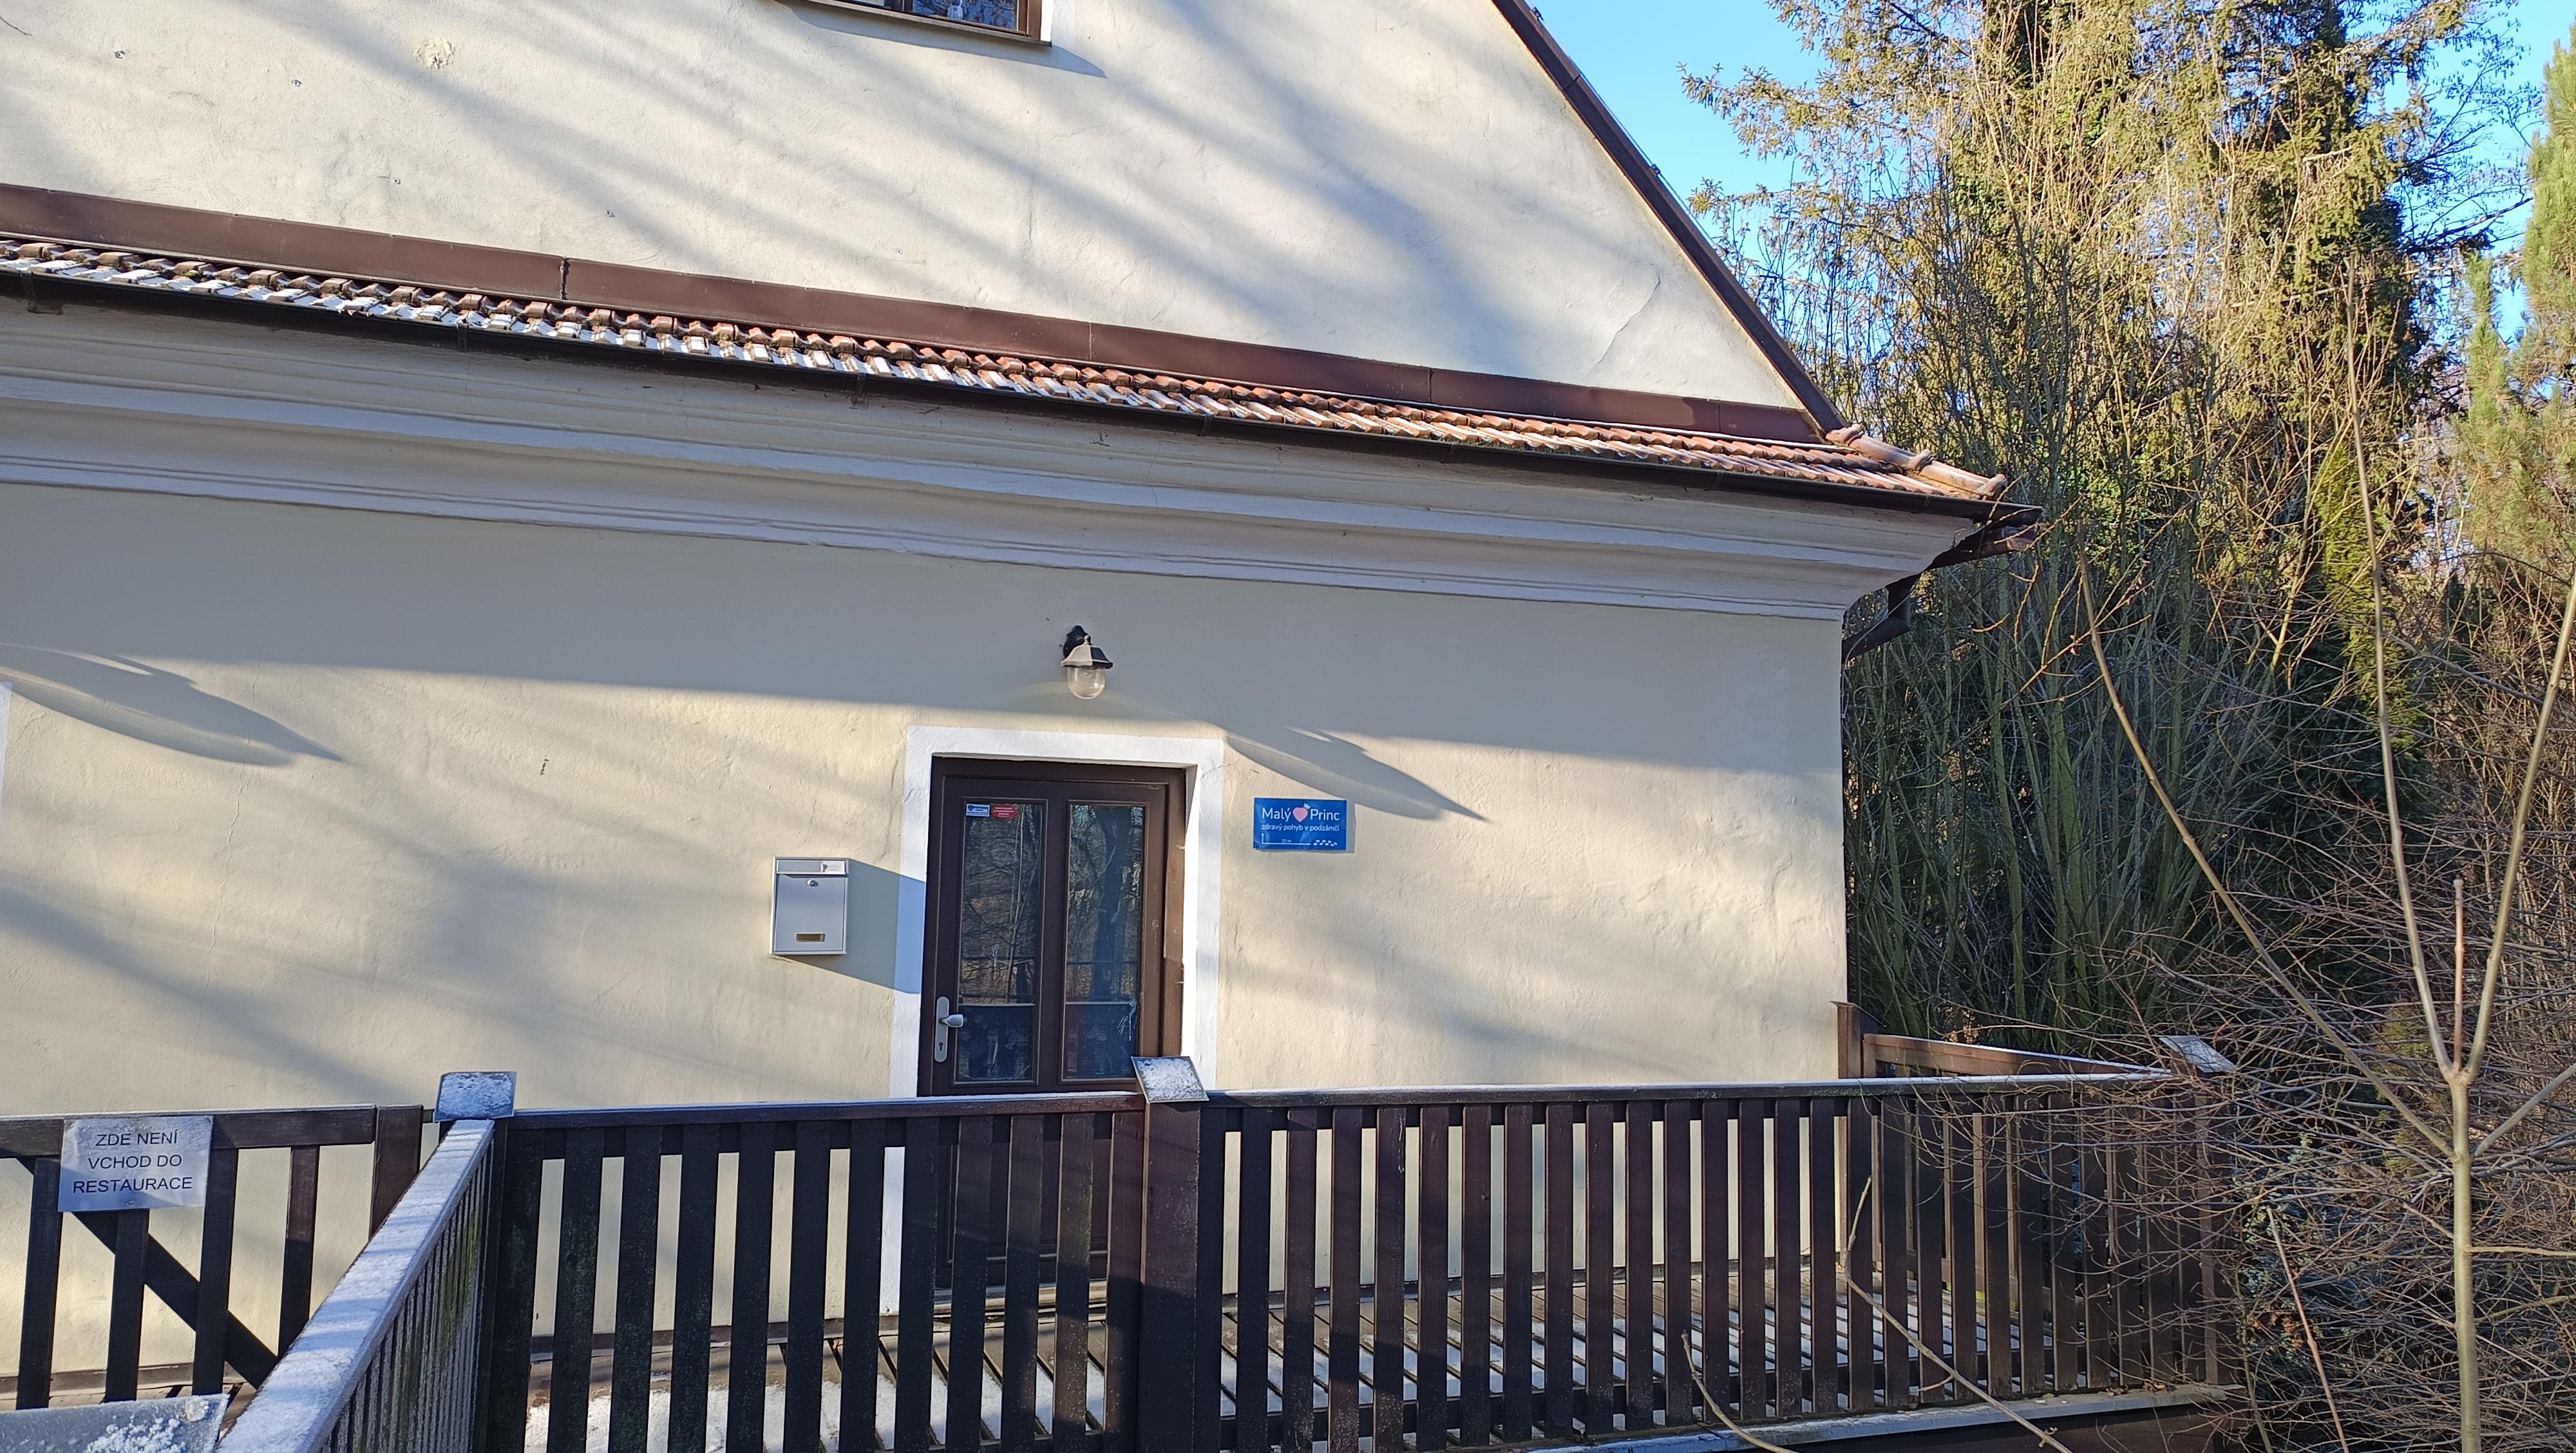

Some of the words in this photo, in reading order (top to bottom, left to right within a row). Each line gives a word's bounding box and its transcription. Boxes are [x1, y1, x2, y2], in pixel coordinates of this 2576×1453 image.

[1262, 807, 1291, 822] Malý
[1310, 808, 1340, 821] Princ
[1261, 823, 1283, 831] zdravý
[95, 1134, 131, 1146] ZDE
[137, 1129, 178, 1145] NENÍ
[88, 1155, 151, 1170] VCHOD
[156, 1154, 182, 1167] DO
[73, 1177, 193, 1193] RESTAURACE
